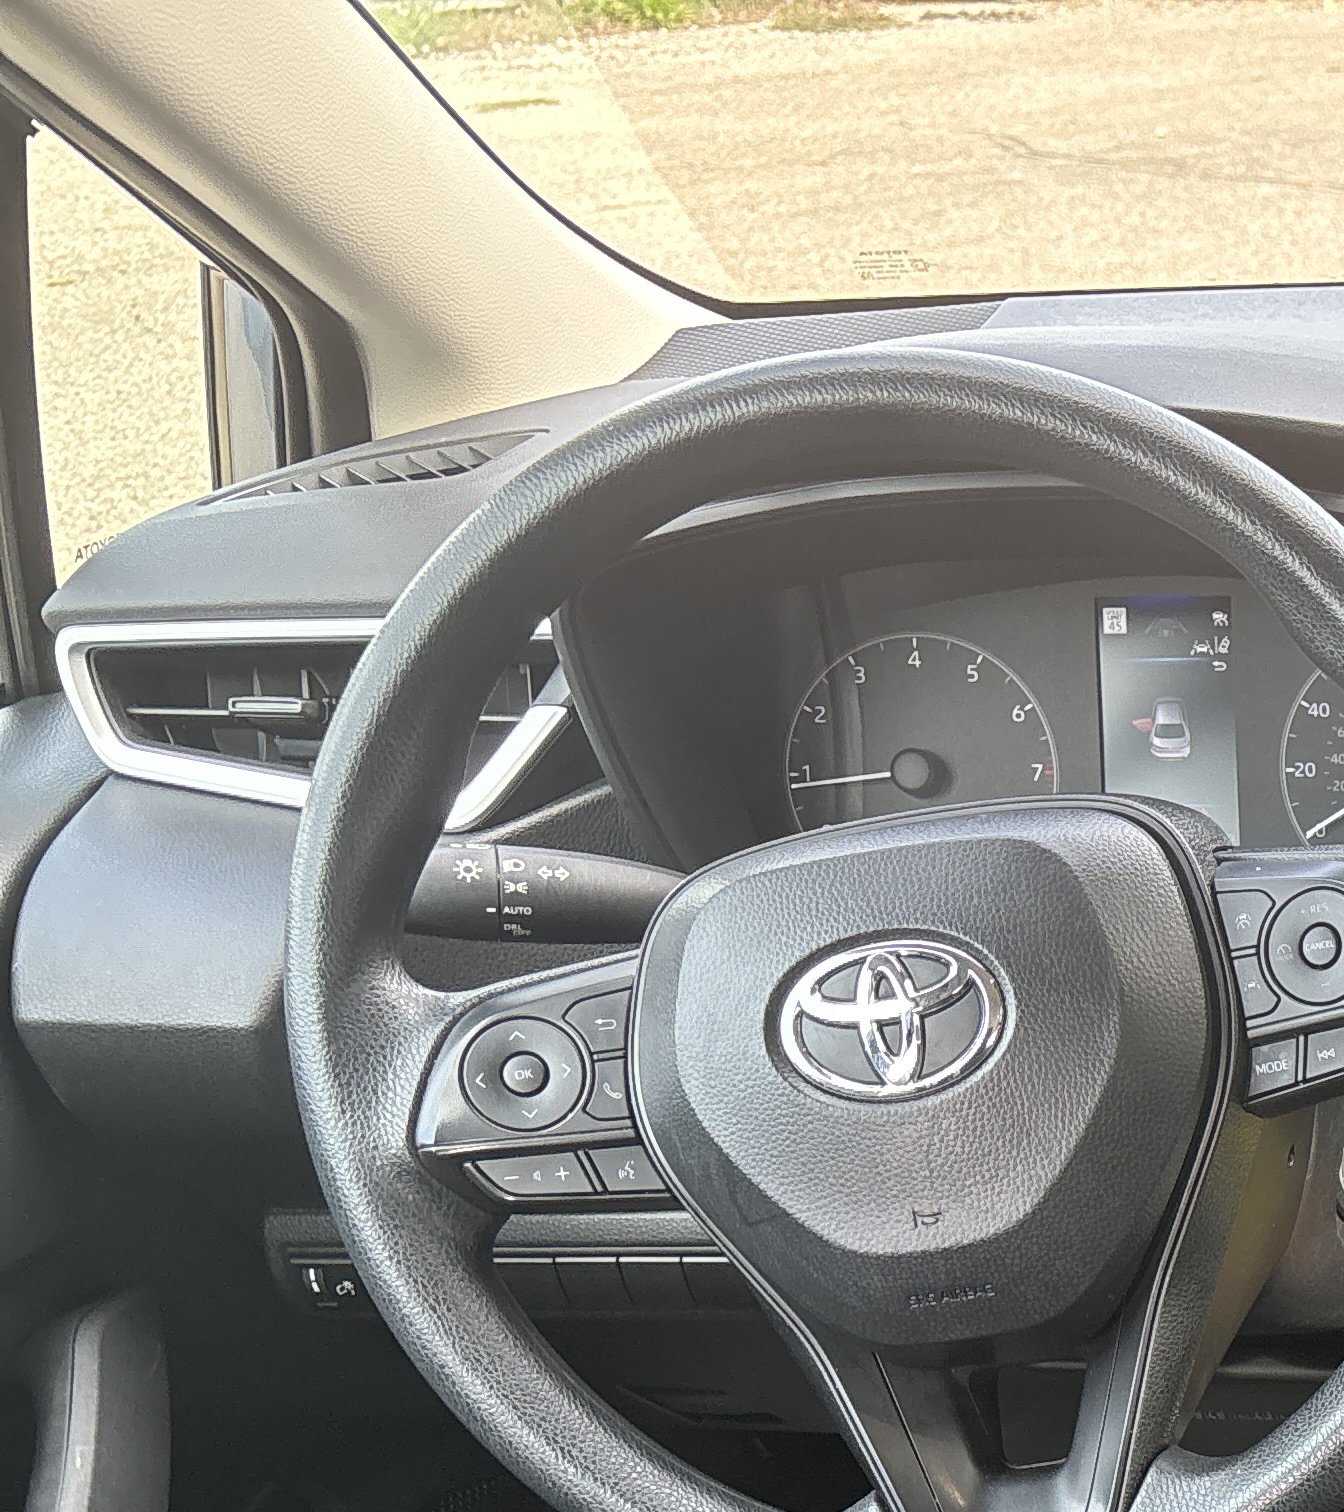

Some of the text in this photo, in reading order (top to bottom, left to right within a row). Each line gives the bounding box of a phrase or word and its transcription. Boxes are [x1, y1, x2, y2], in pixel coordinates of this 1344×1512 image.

[1108, 620, 1122, 632] 45
[907, 651, 922, 668] 4
[854, 666, 866, 684] 3
[966, 664, 979, 683] 5
[814, 706, 827, 724] 2
[1011, 704, 1026, 722] 6
[1307, 702, 1330, 718] 40
[802, 765, 811, 781] 1
[1031, 764, 1043, 782] 7
[1294, 762, 1316, 778] 20
[503, 905, 533, 916] AUTO
[503, 923, 522, 932] DRL
[1306, 939, 1335, 952] CANCEL
[515, 1067, 534, 1081] OK
[1256, 1059, 1289, 1075] MODE
